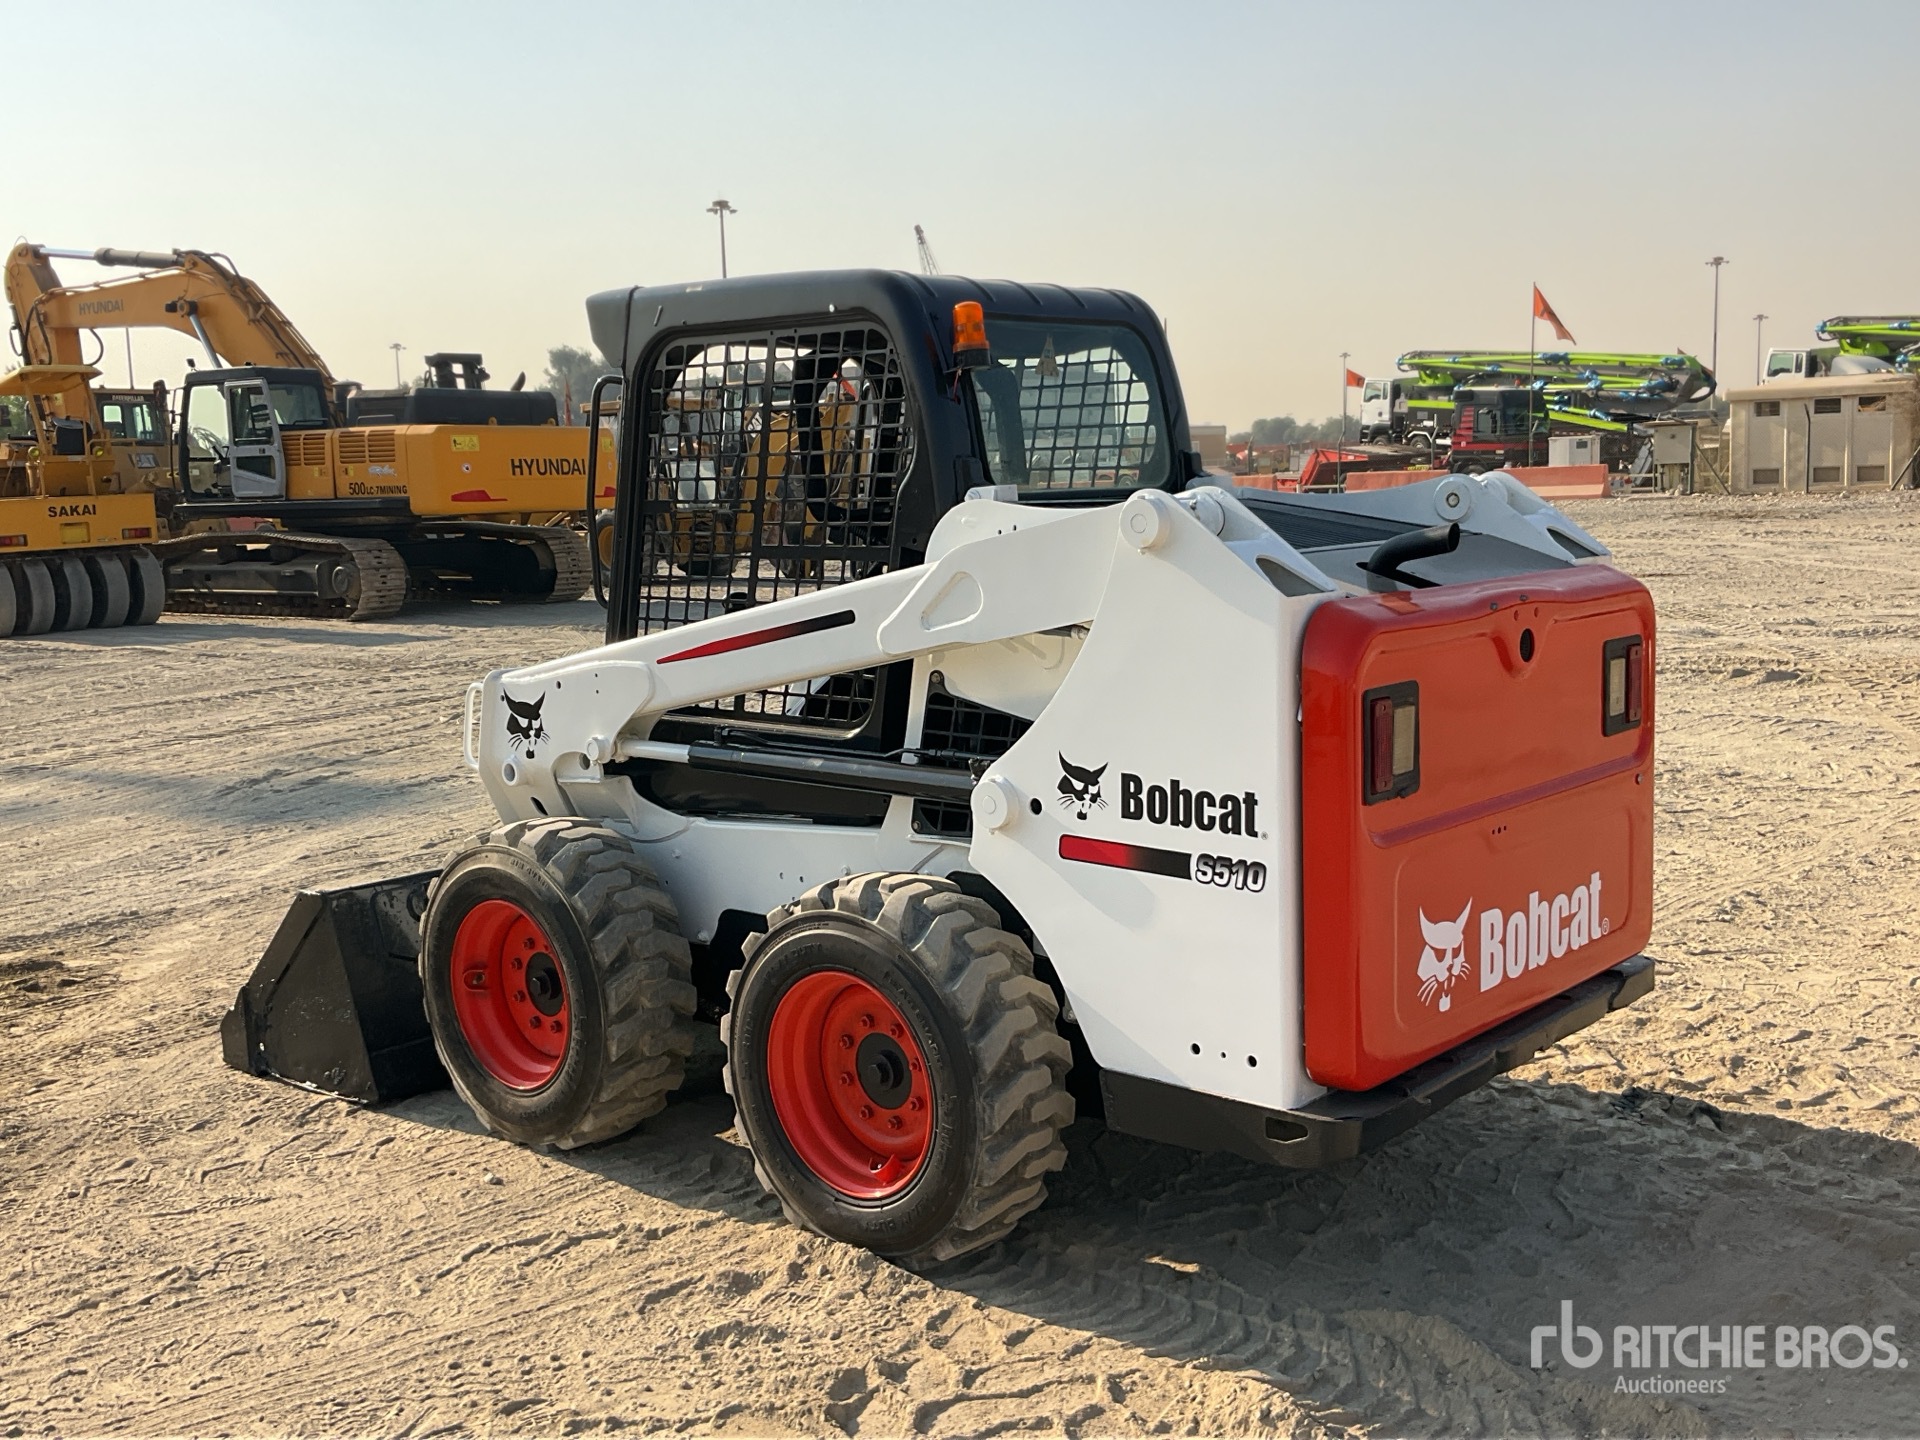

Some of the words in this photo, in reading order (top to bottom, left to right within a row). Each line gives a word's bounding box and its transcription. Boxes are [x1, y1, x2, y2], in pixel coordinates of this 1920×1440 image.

[79, 299, 124, 316] HYUNDAI
[510, 458, 587, 476] HYUNDAI
[48, 504, 97, 518] SAKAI
[1120, 772, 1259, 838] Bobcat
[1195, 853, 1267, 893] S510
[1480, 871, 1603, 992] Bobcat
